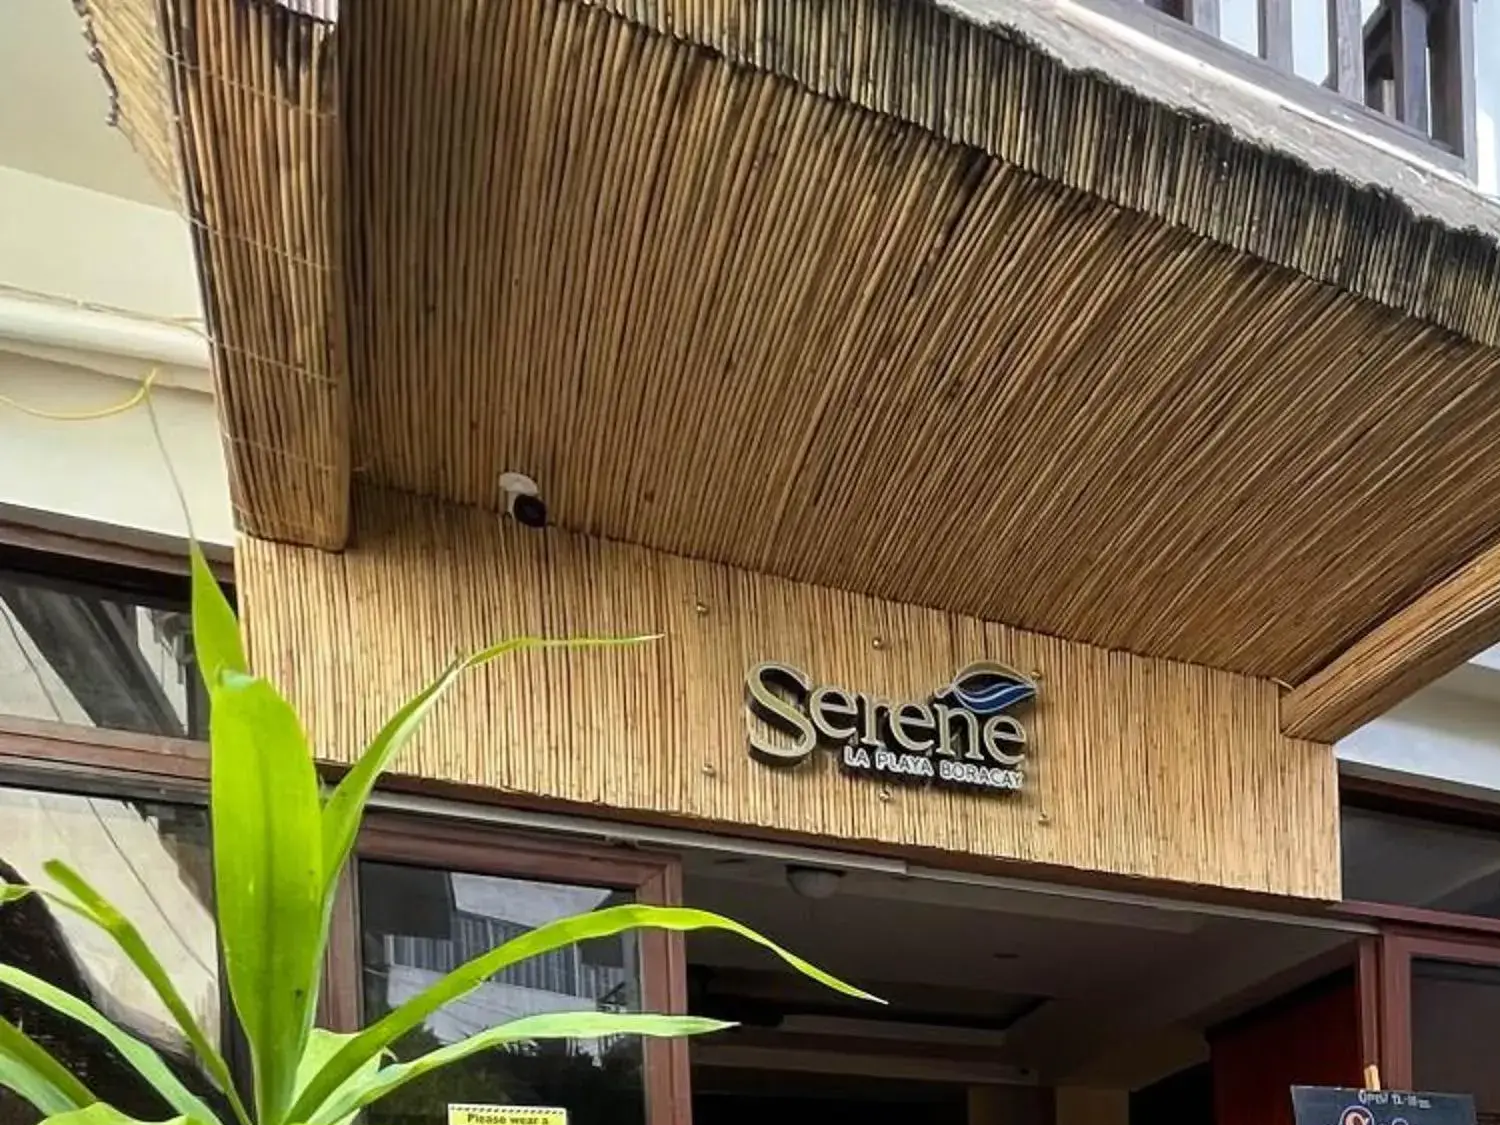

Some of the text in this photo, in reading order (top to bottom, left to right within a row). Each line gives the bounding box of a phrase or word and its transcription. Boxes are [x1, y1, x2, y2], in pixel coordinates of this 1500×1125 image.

[746, 661, 1027, 765] Serene
[844, 745, 1024, 788] LA PLAYA BORACAY
[467, 1113, 549, 1125] Please wear a
